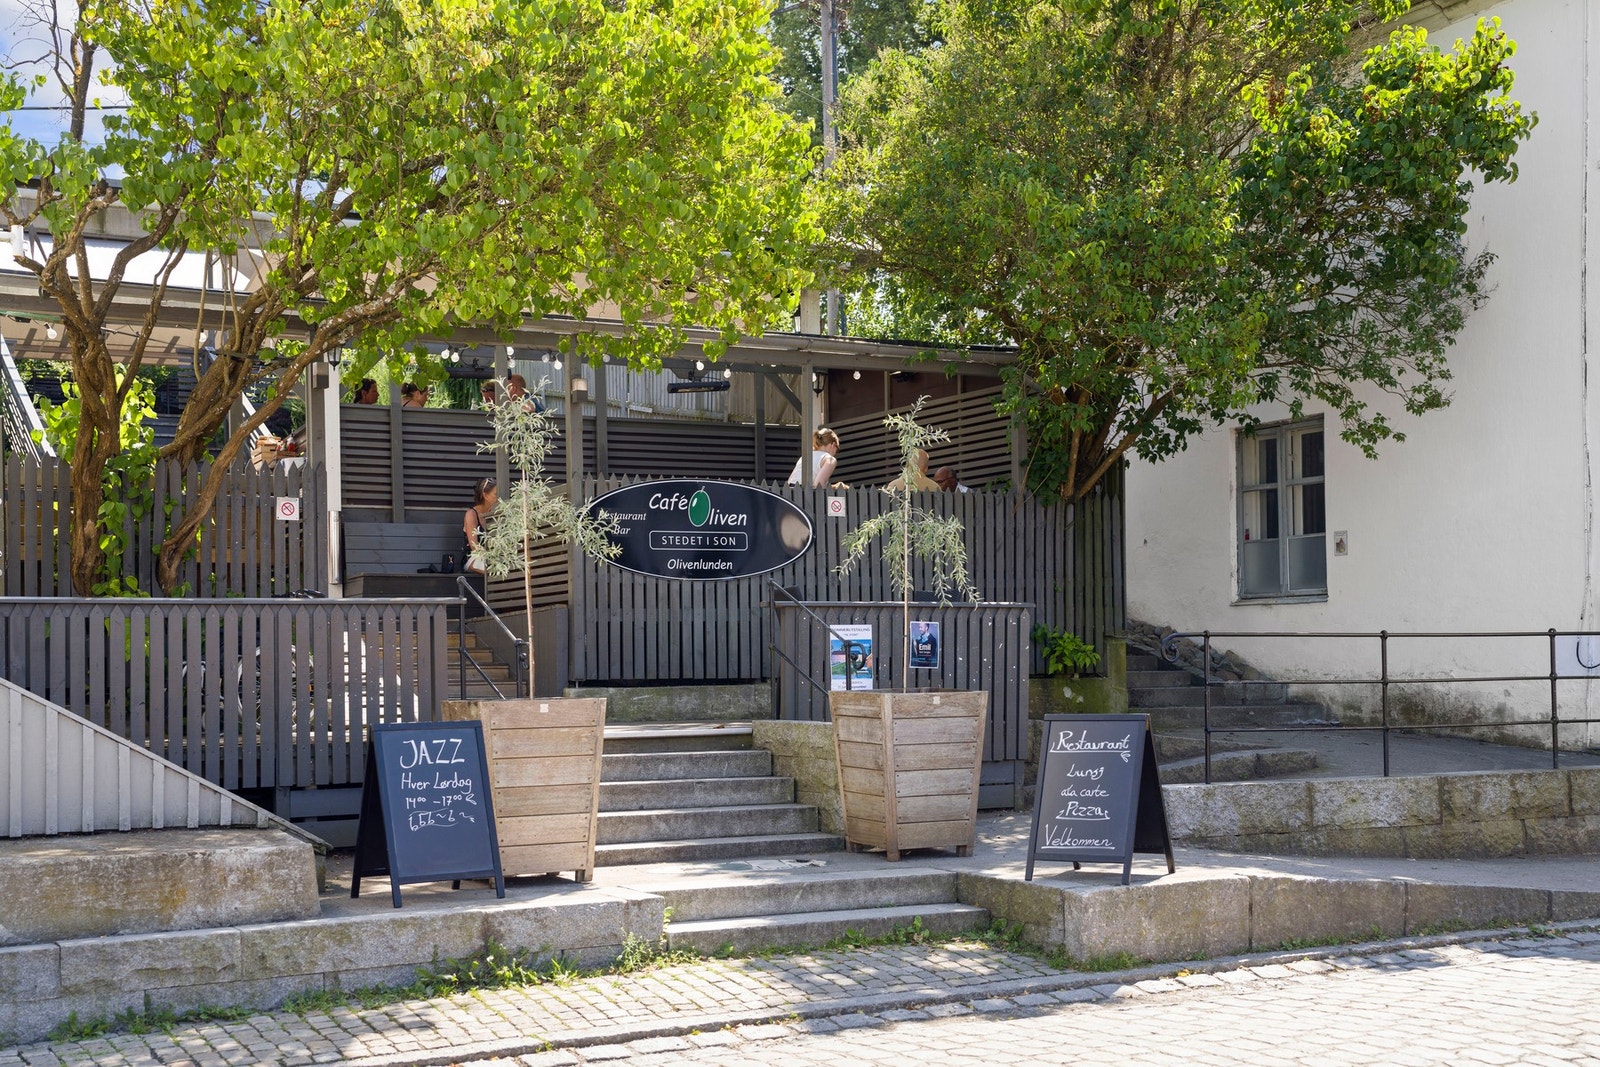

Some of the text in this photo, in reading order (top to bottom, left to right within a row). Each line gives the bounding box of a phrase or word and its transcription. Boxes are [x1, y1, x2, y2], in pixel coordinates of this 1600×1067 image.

[649, 493, 688, 511] Café
[613, 525, 631, 535] Bar
[661, 535, 703, 546] STEDET
[713, 536, 736, 546] SON
[667, 558, 733, 570] Olivenlunden
[1057, 730, 1131, 750] Restaurant
[400, 738, 465, 769] JAZZ
[401, 772, 431, 790] Hver
[1079, 784, 1110, 797] carte
[1065, 801, 1102, 816] Pizza
[1045, 824, 1112, 846] Velkommen
